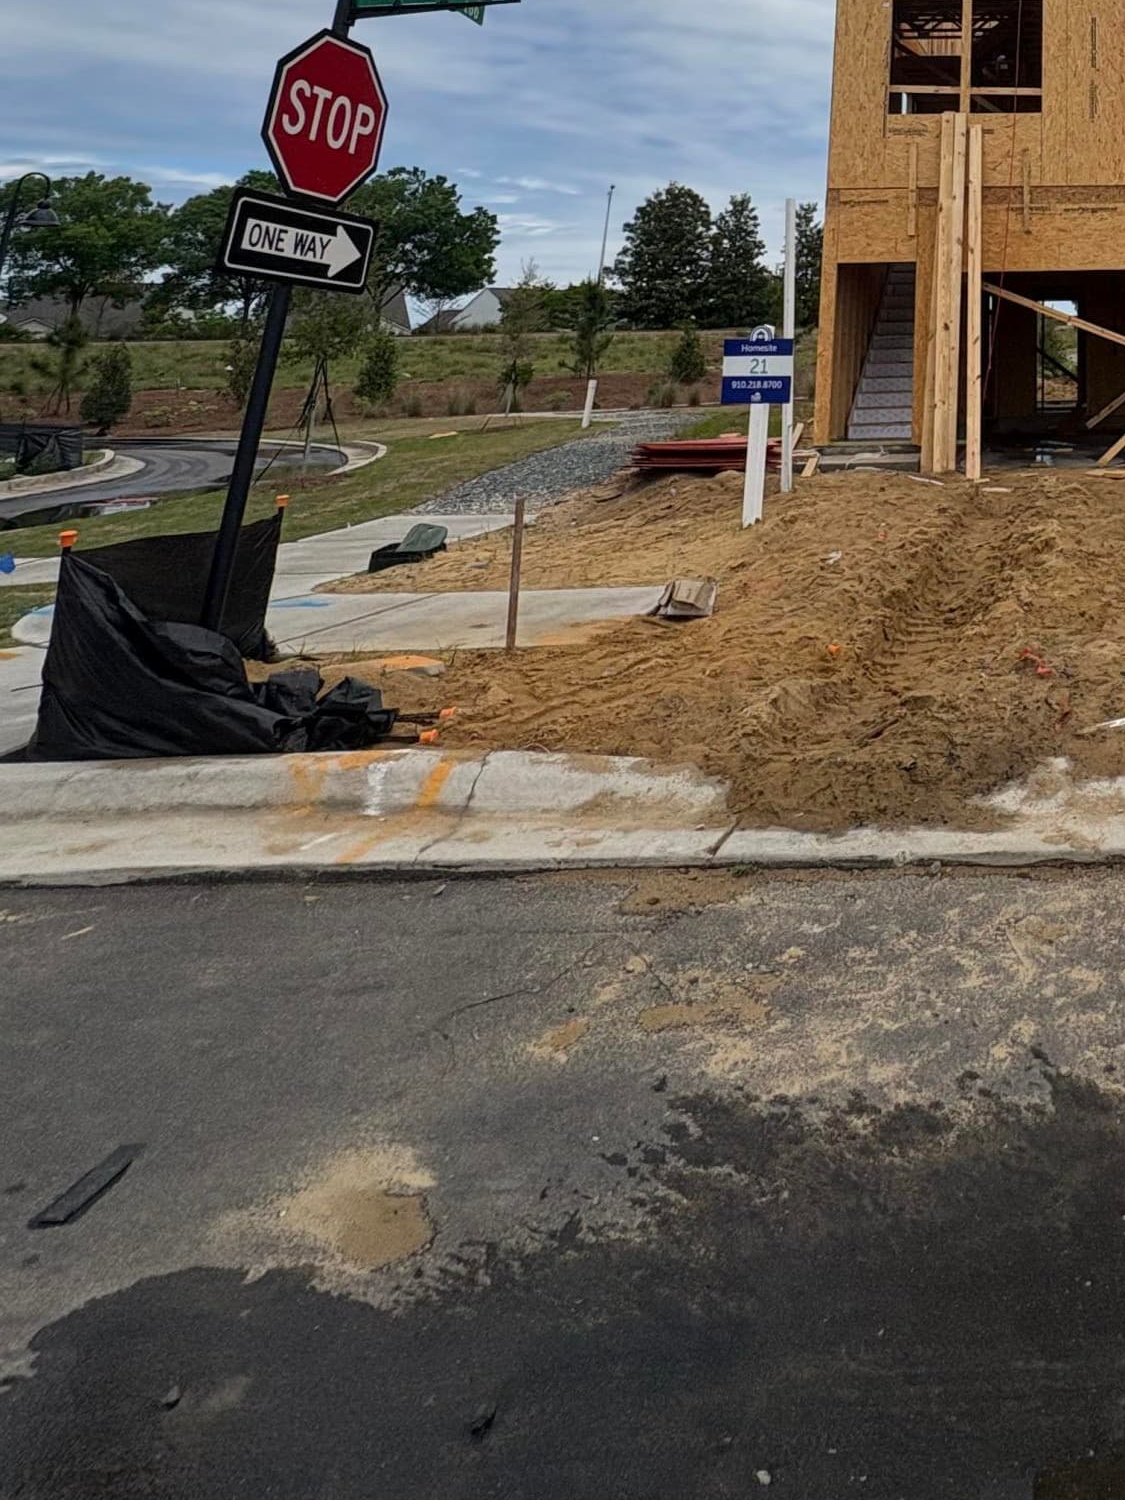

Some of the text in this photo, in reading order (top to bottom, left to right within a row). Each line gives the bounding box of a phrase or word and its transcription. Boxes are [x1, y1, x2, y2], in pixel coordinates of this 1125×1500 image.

[282, 79, 376, 155] STOP
[248, 223, 332, 260] ONE WAY
[741, 344, 778, 352] Homesite
[749, 358, 768, 374] 21
